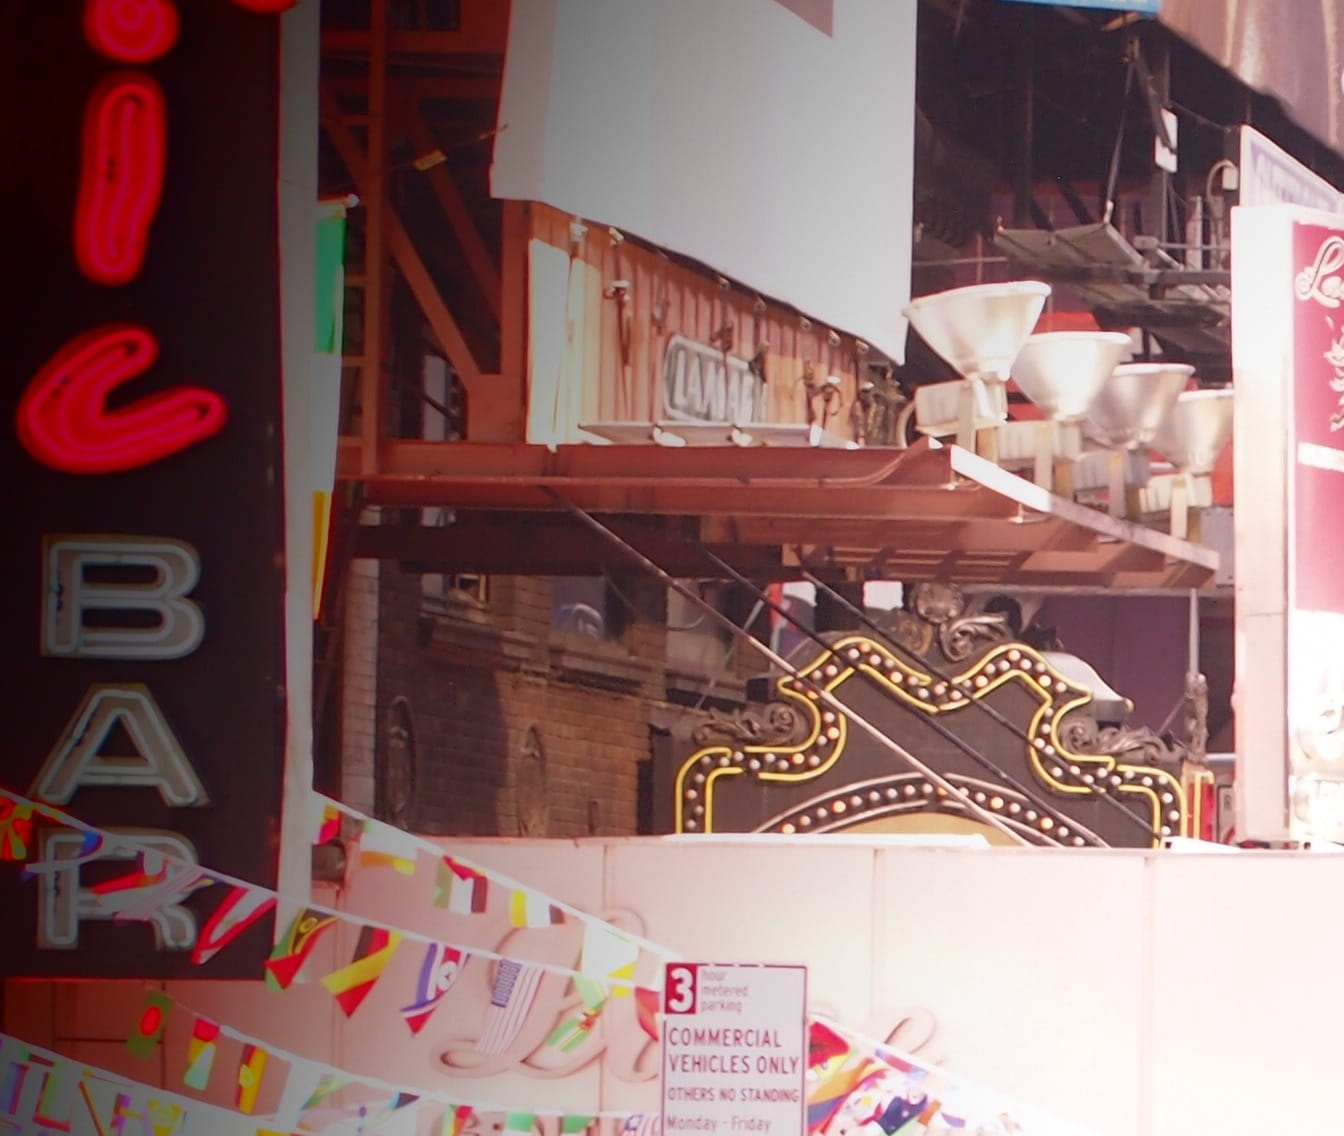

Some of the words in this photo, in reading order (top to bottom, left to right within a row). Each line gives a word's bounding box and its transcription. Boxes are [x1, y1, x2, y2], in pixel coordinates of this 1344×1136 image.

[27, 533, 214, 951] BAR
[668, 967, 694, 1013] 3
[702, 984, 749, 998] metered
[701, 1000, 743, 1015] parking
[668, 1027, 782, 1049] COMMERCIAL
[668, 1054, 751, 1074] VEHICLES
[756, 1055, 801, 1075] ONLY
[668, 1087, 715, 1102] OTHERS
[719, 1087, 737, 1102] NO
[739, 1088, 801, 1103] STANDING
[666, 1115, 717, 1132] Monday
[731, 1115, 772, 1133] Friday
